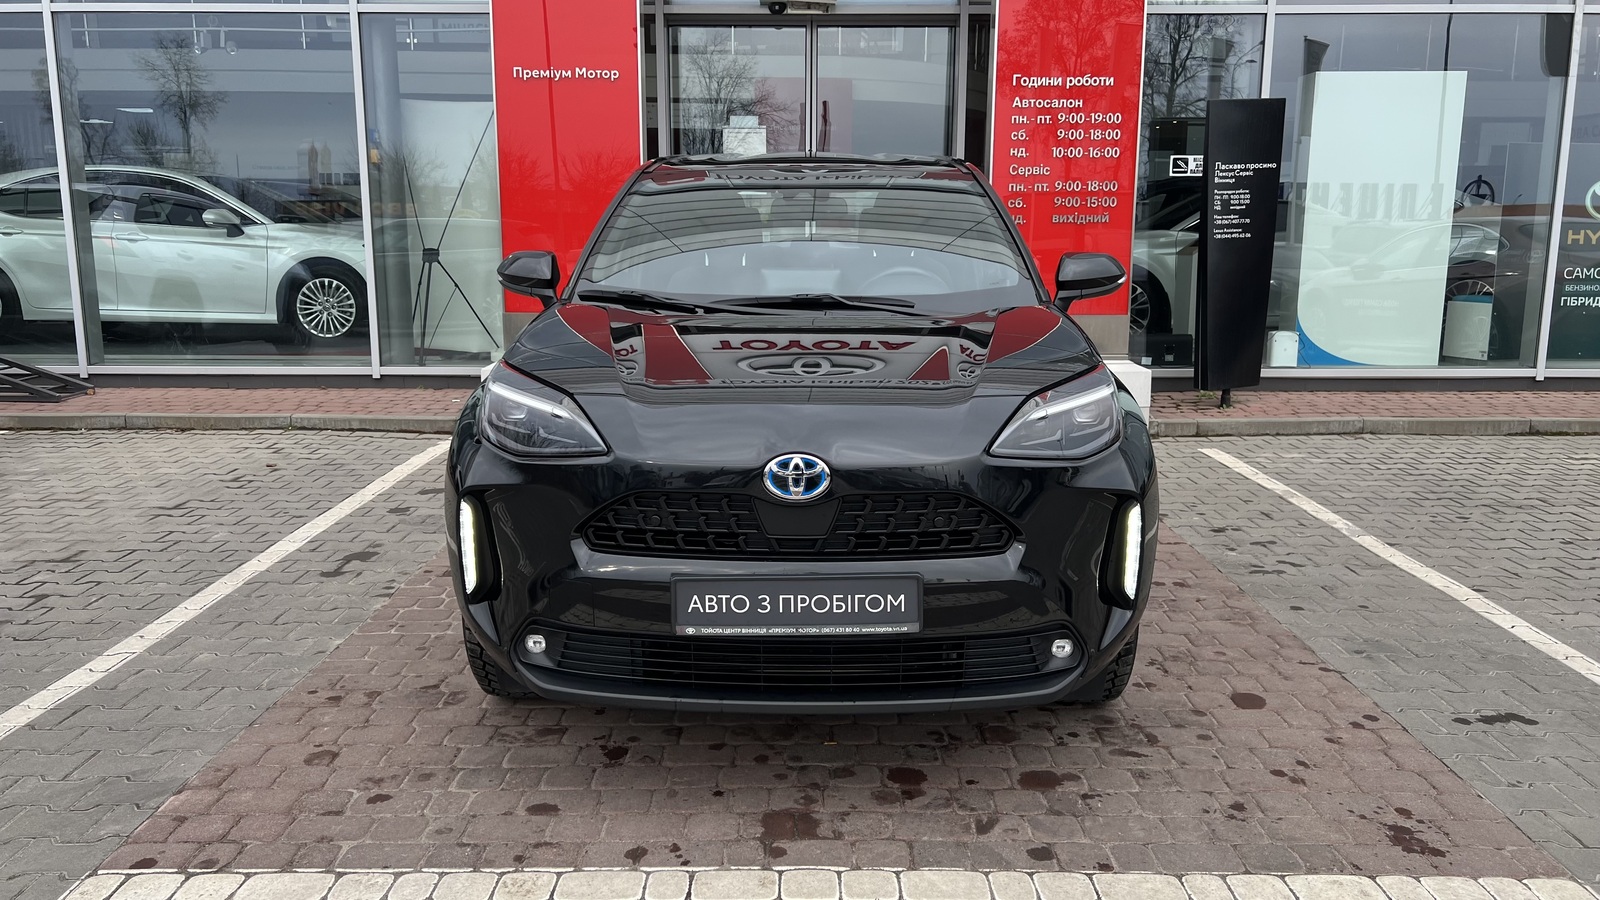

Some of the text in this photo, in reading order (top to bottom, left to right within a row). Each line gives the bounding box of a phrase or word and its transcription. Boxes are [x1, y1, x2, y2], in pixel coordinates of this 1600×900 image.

[513, 66, 620, 82] Преміум Мотор
[1012, 74, 1115, 89] Години роботи
[1012, 96, 1083, 108] Автосалон
[1057, 112, 1122, 125] 9:00-19:00
[1010, 129, 1121, 141] сб. 9:00-18:00
[1010, 147, 1120, 158] нд. 10:00-16:00
[1009, 164, 1050, 177] Сервіс
[1054, 181, 1118, 192] 9:00-18:00
[1008, 196, 1117, 208] сб. 9:00-15:00
[1052, 212, 1110, 224] вихідний
[688, 593, 905, 613] АВТО З ПРОБІГОМ
